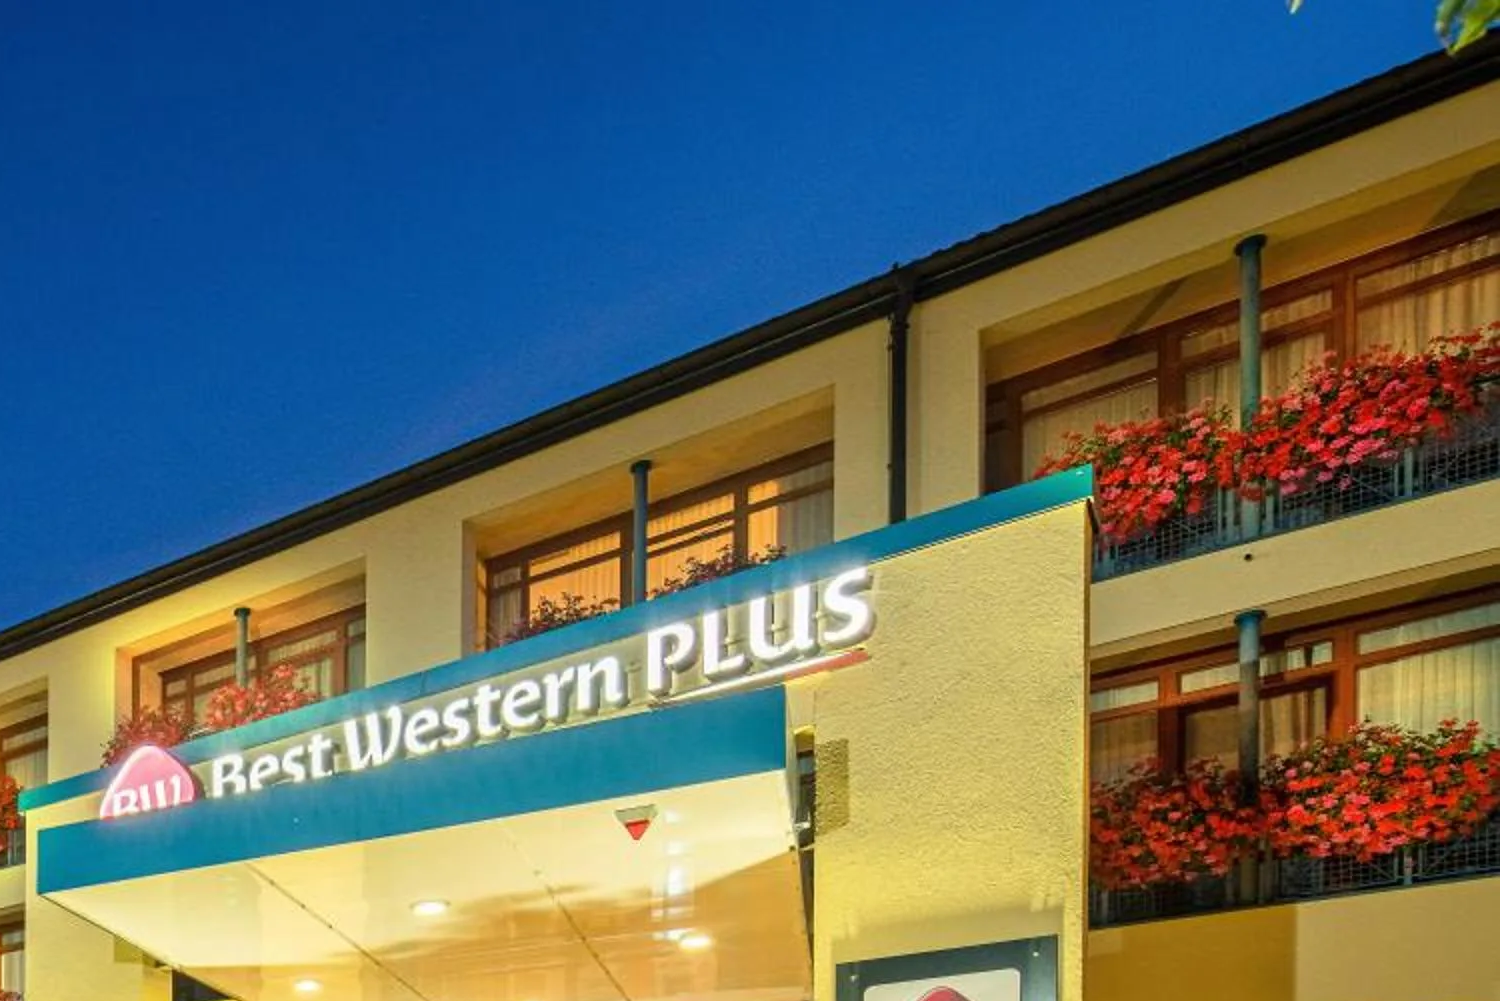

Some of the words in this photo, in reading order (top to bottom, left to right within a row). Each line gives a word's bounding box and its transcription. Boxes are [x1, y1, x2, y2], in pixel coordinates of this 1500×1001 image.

[211, 733, 334, 799] Best
[344, 655, 623, 772] Western
[647, 565, 873, 693] PLUS
[112, 774, 182, 817] BW
